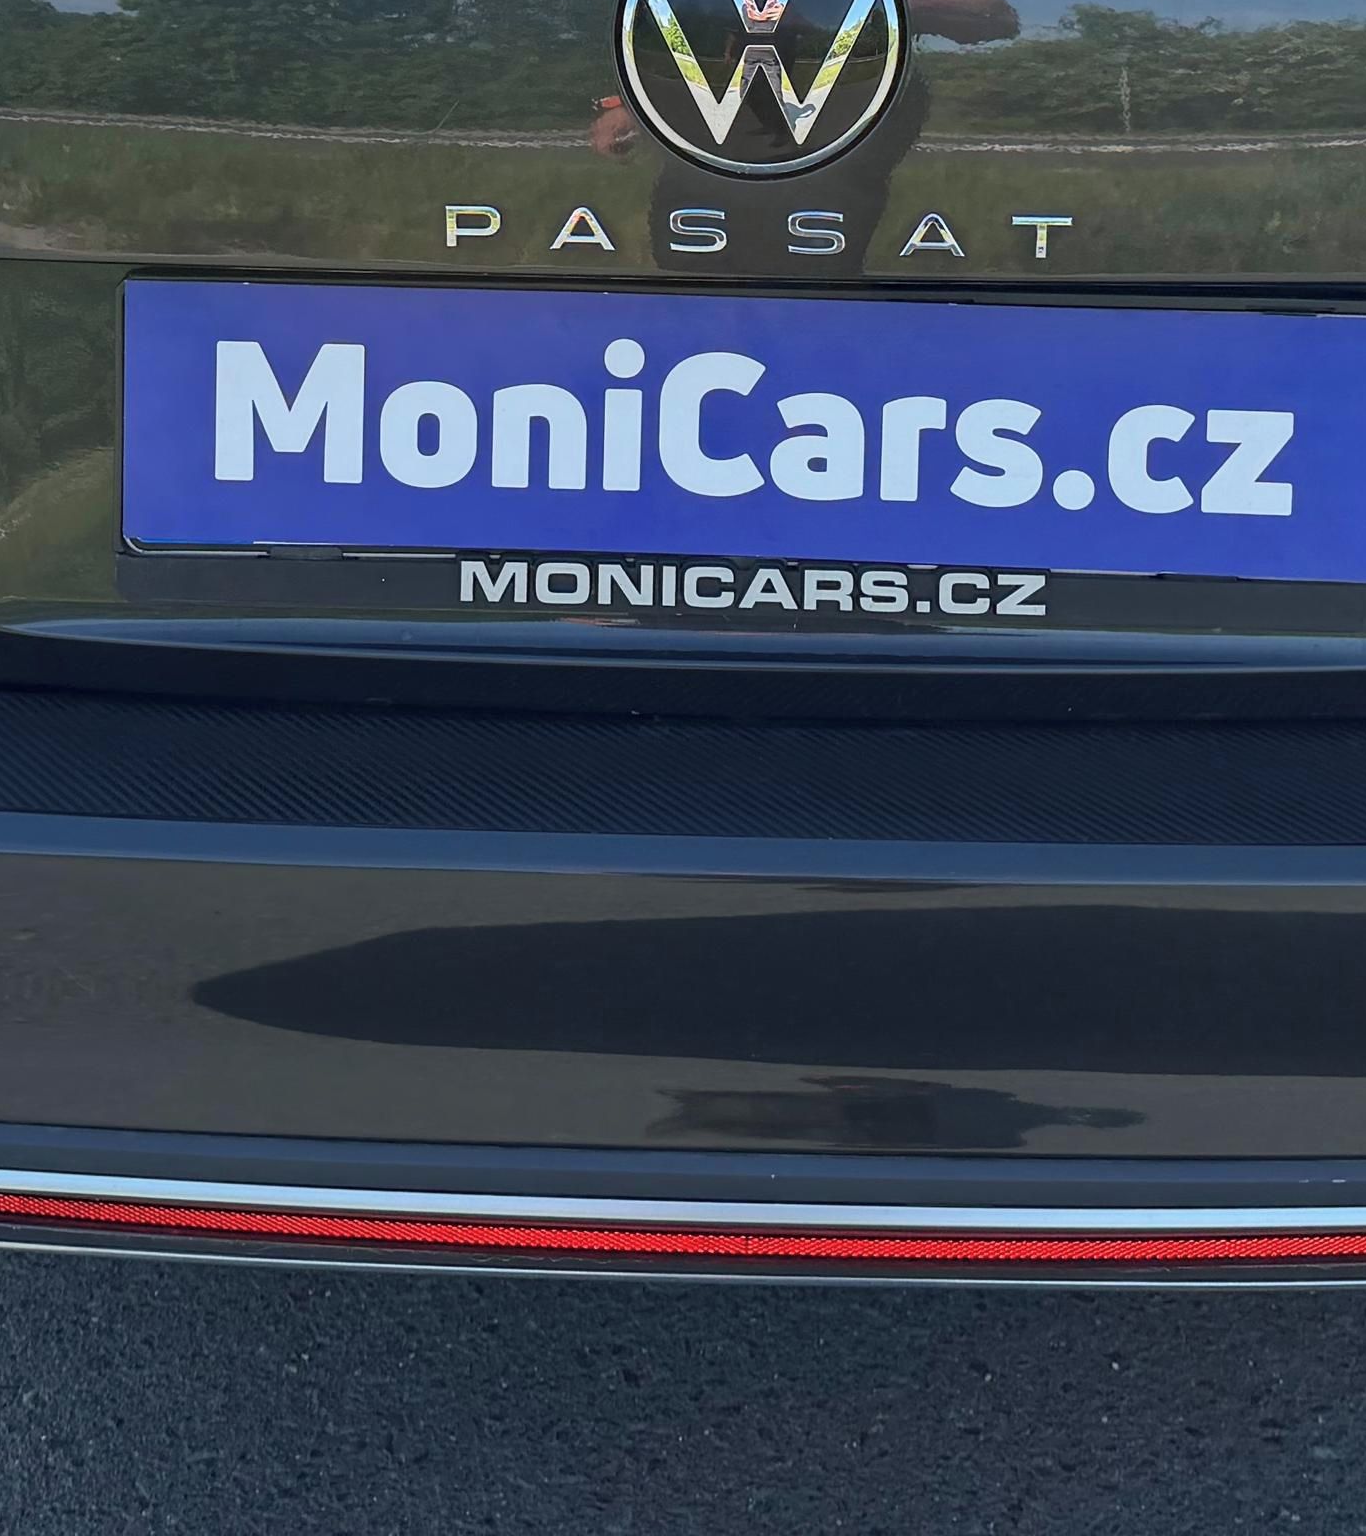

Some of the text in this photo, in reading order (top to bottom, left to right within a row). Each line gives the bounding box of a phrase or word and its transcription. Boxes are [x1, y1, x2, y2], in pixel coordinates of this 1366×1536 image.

[443, 205, 1075, 259] PASSAT
[213, 337, 1295, 516] MoniCars.cz
[459, 560, 1047, 617] MONICARS.CZ
